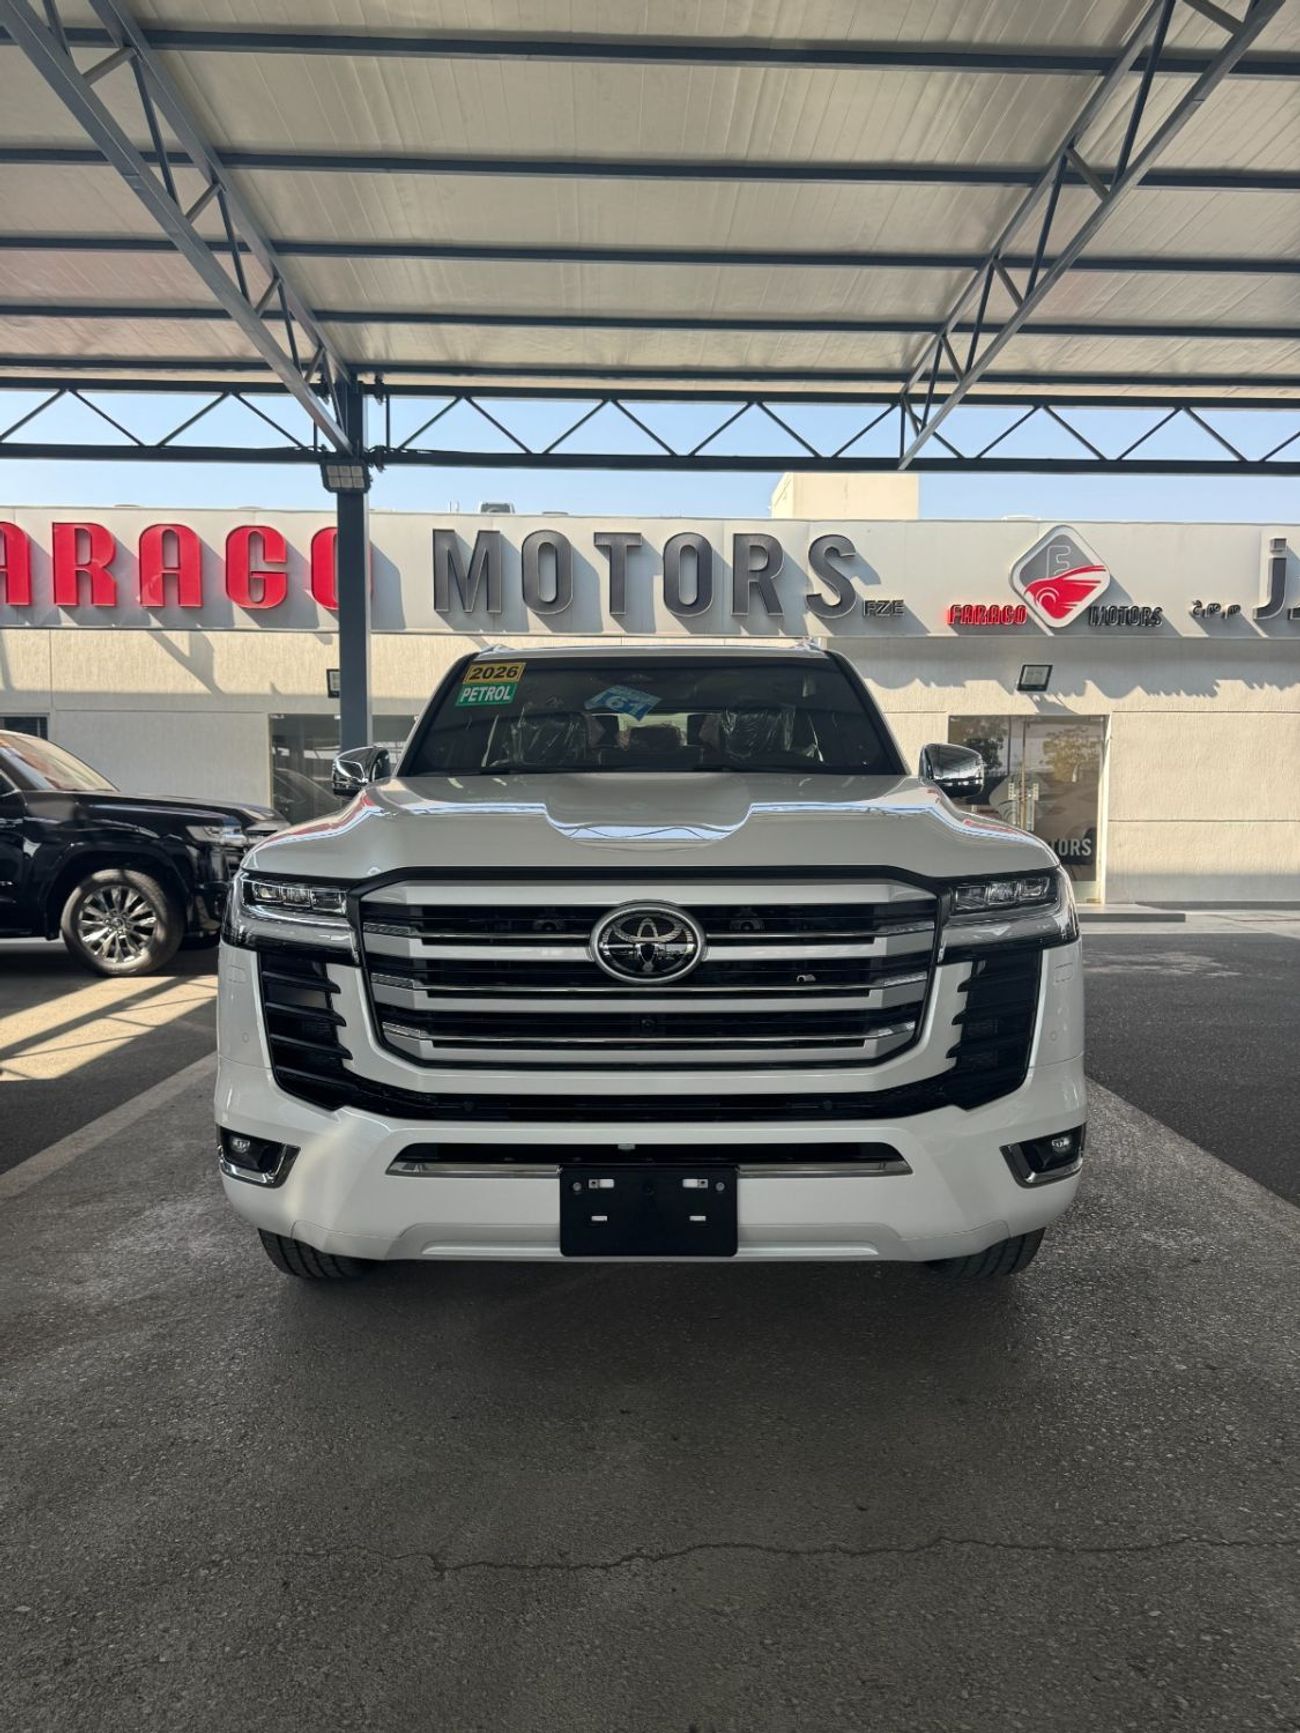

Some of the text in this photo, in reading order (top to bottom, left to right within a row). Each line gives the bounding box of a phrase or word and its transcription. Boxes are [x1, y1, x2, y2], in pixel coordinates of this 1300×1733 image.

[432, 528, 857, 618] MOTORS
[864, 599, 905, 617] FZE
[948, 603, 1164, 628] FARAGO MOTORS
[469, 665, 519, 680] 2026
[460, 685, 512, 703] PETROL
